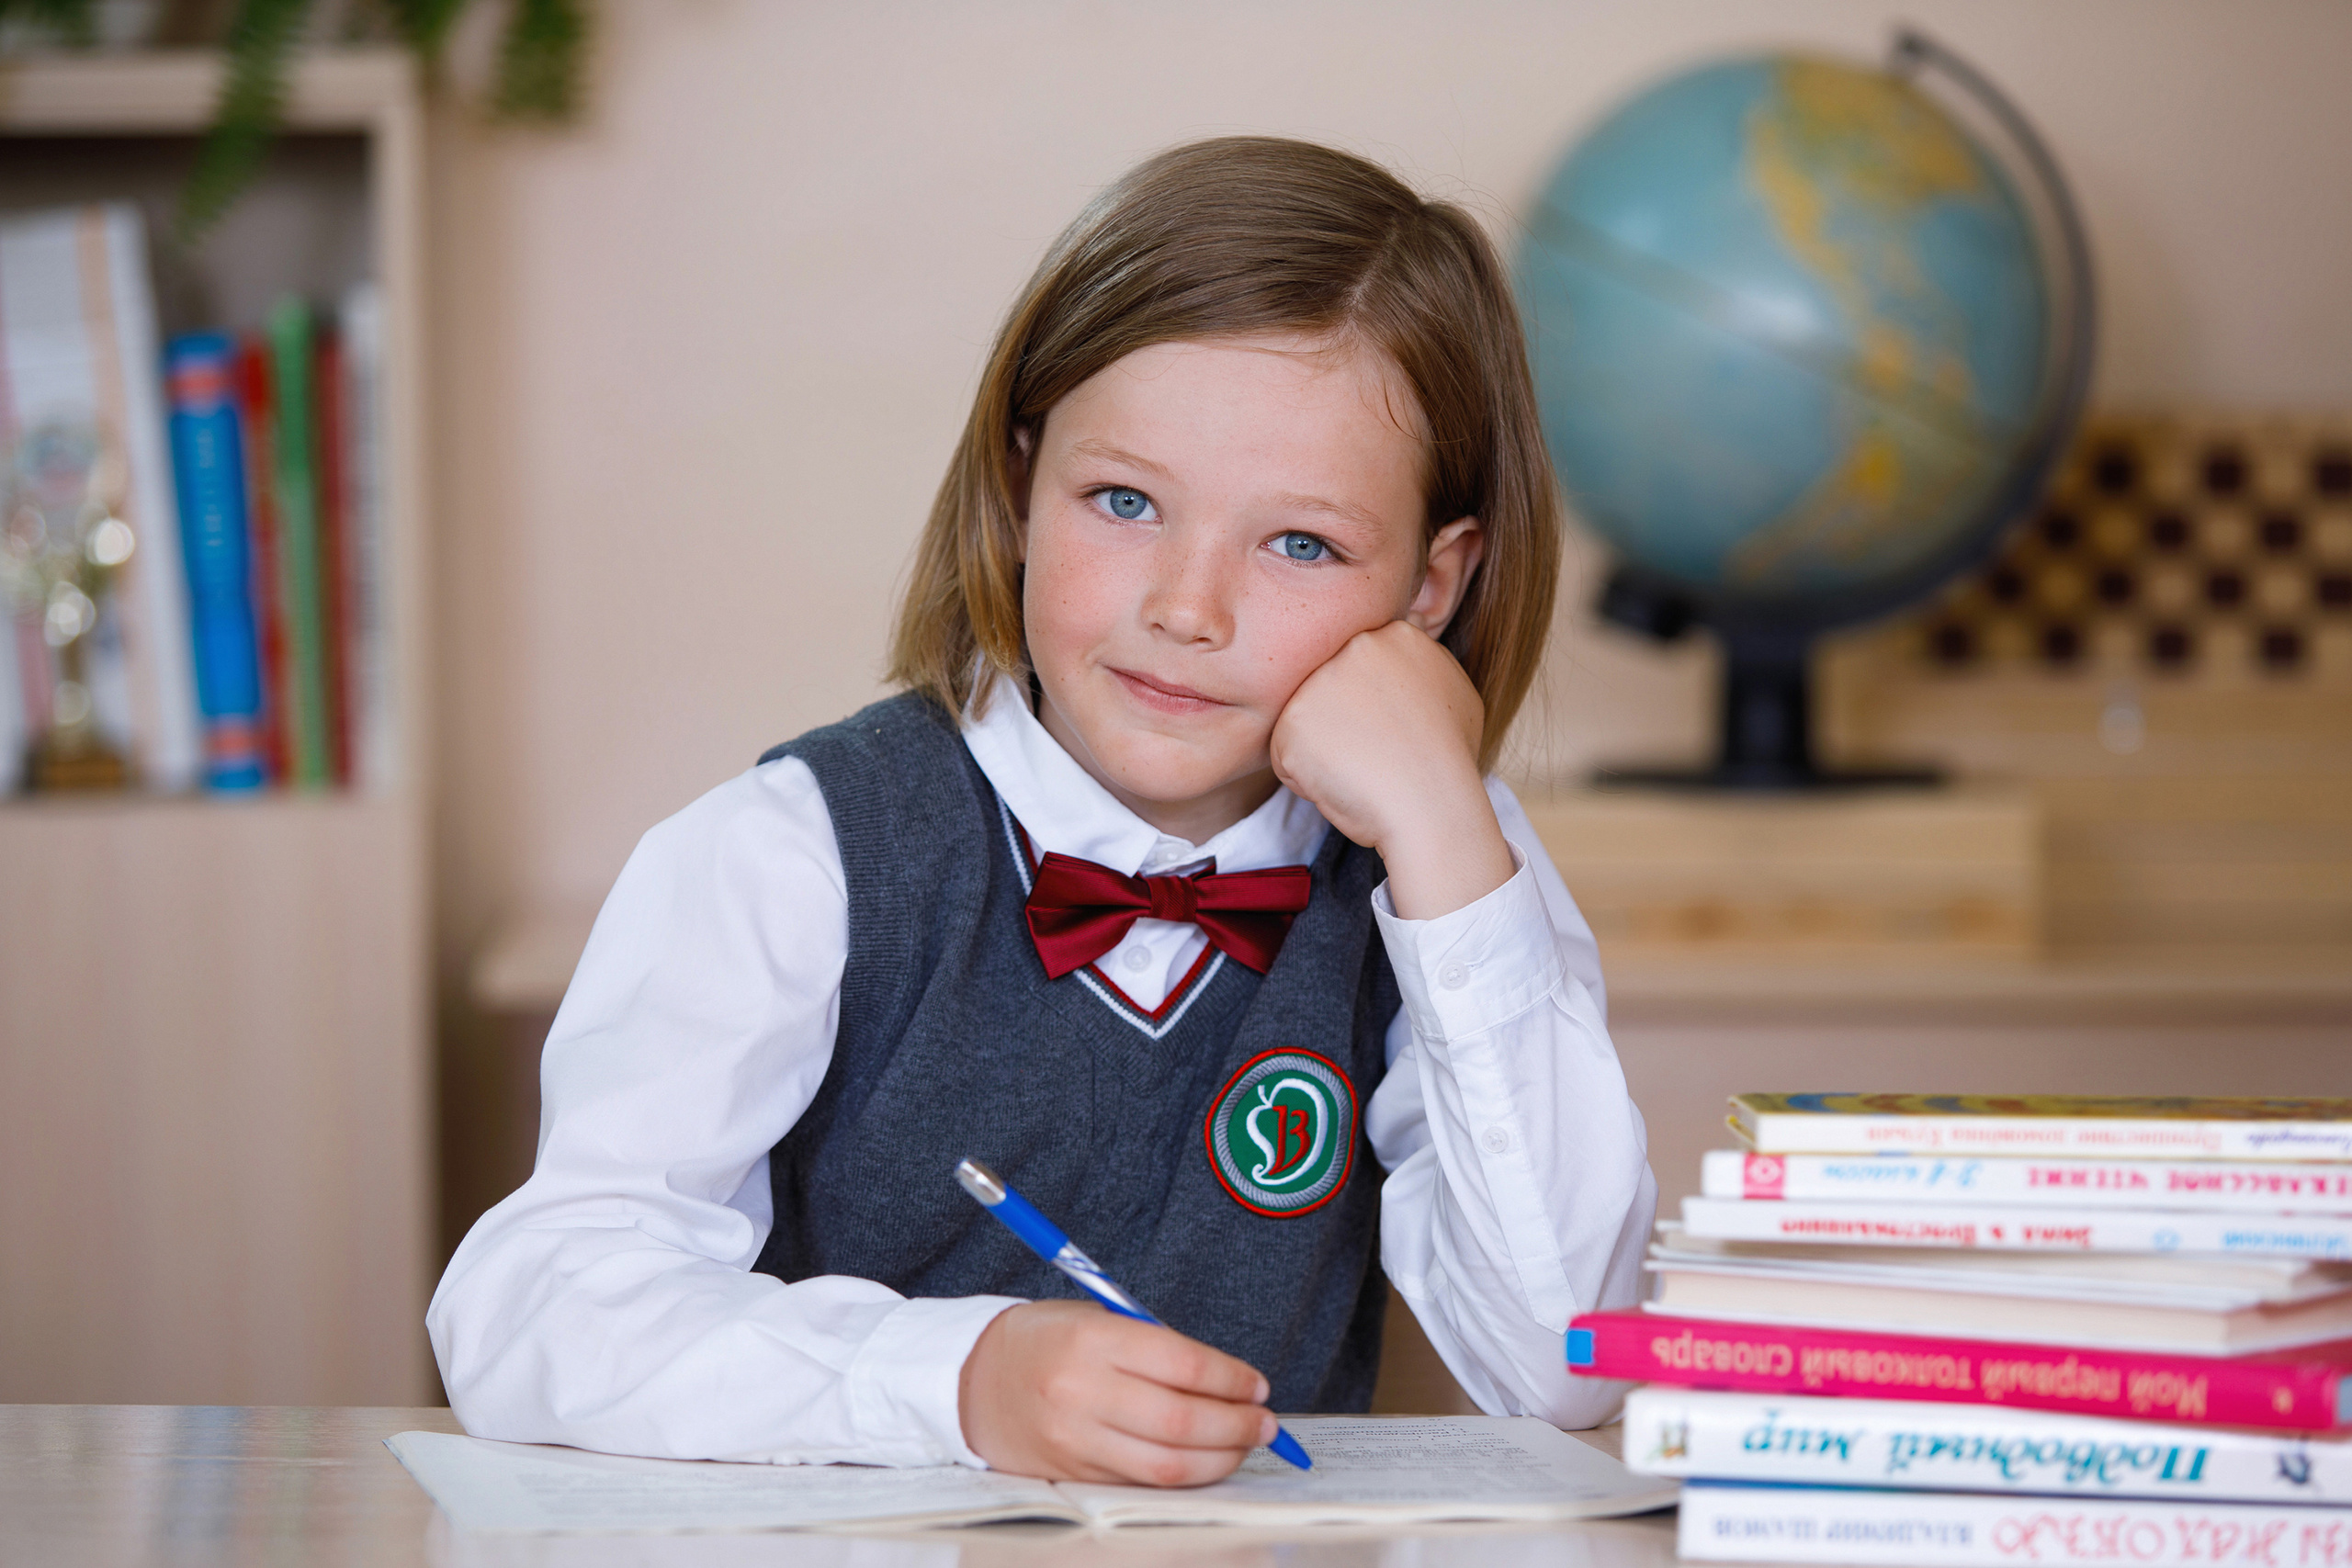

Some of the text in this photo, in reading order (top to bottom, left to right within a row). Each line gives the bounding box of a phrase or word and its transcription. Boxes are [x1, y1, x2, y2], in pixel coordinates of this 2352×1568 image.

[1651, 1328, 2208, 1418] Мой первый толковый словарь
[1742, 1404, 2210, 1484] Подводный мир
